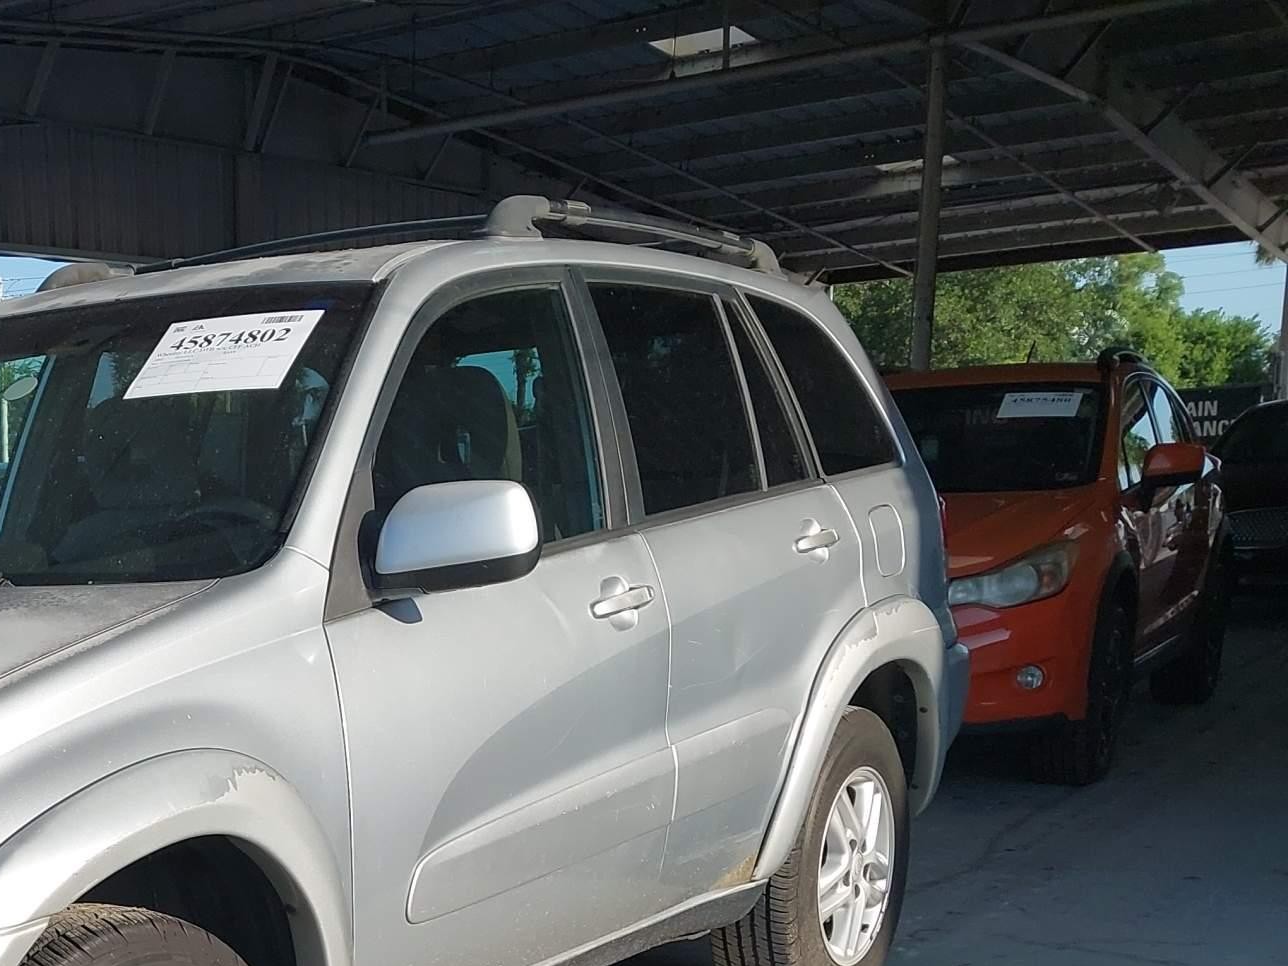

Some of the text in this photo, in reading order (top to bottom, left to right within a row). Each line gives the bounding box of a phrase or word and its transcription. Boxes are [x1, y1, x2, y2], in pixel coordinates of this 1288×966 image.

[170, 327, 292, 351] 45874802
[1186, 400, 1218, 417] AIN
[1192, 420, 1236, 437] ANC
